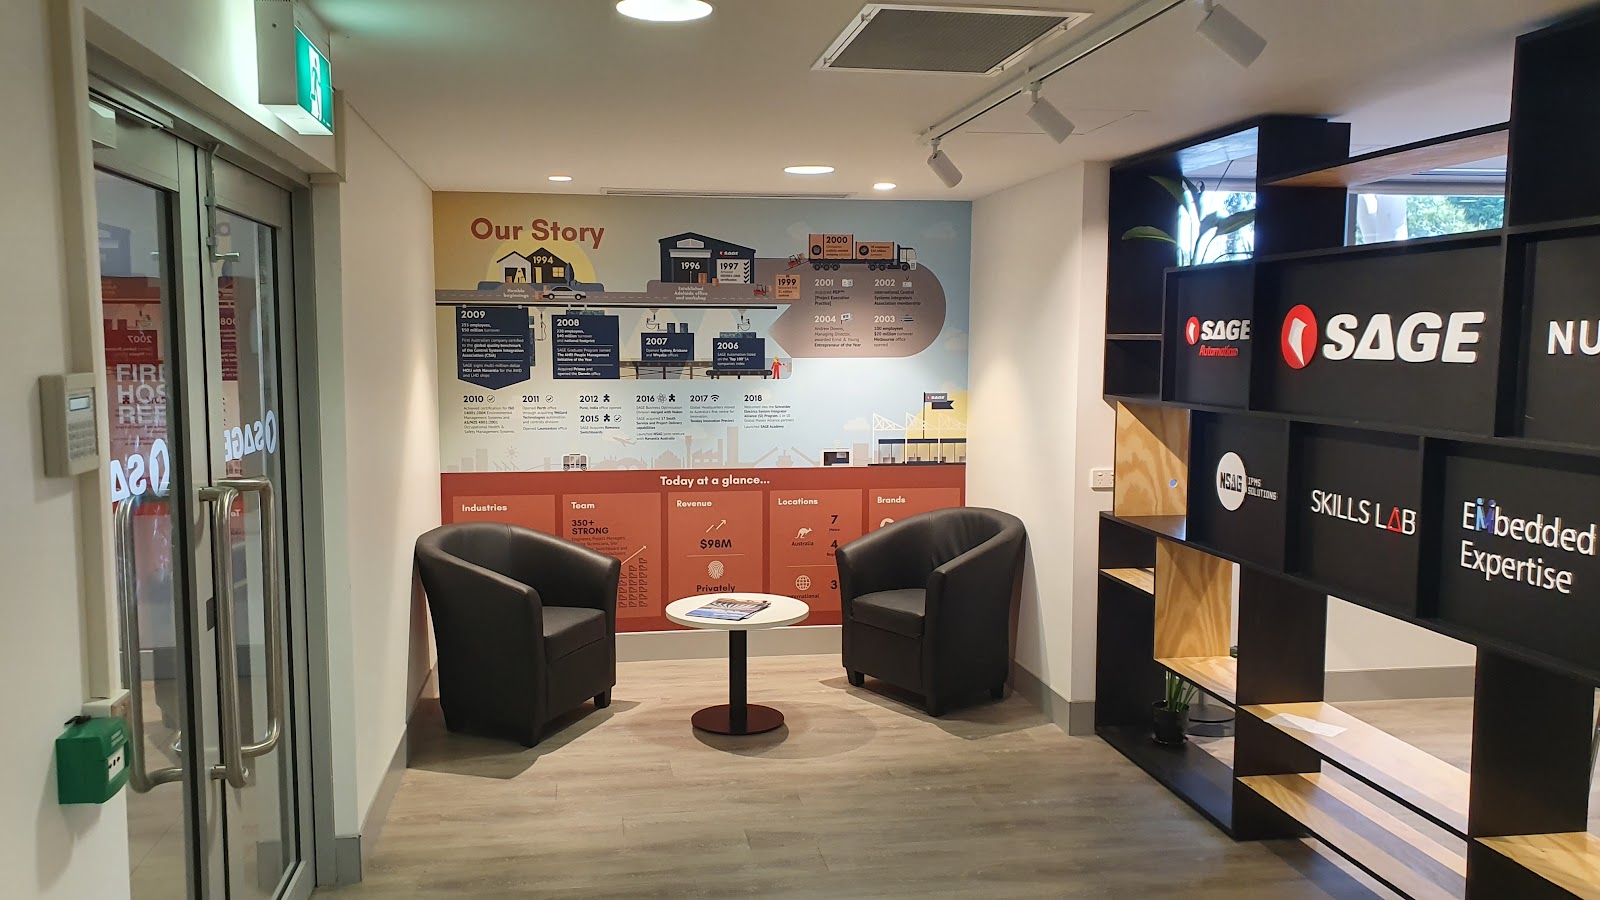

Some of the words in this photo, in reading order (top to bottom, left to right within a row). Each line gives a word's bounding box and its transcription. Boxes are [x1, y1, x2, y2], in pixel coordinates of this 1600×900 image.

[470, 218, 523, 240] Our
[532, 218, 604, 249] Story
[532, 256, 554, 264] 1994
[681, 262, 700, 270] 1996
[461, 310, 485, 318] 2009
[1201, 320, 1250, 340] SAGE
[1323, 312, 1486, 363] SAGE
[1548, 320, 1600, 355] NU
[1199, 344, 1238, 356] Automation
[661, 476, 694, 488] Today
[697, 476, 708, 485] at
[722, 474, 770, 487] glance...
[1220, 472, 1242, 492] NSAG
[1248, 476, 1261, 487] IPMS
[1248, 487, 1276, 500] SOLUTIONS
[462, 504, 507, 512] Industries
[1311, 490, 1371, 524] SKILLS
[1375, 503, 1416, 535] LAB
[830, 515, 838, 525] 7
[700, 539, 732, 549] $98M
[830, 540, 838, 548] 4
[1460, 540, 1572, 594] Expertise
[696, 584, 736, 592] Privately
[831, 580, 837, 589] 3
